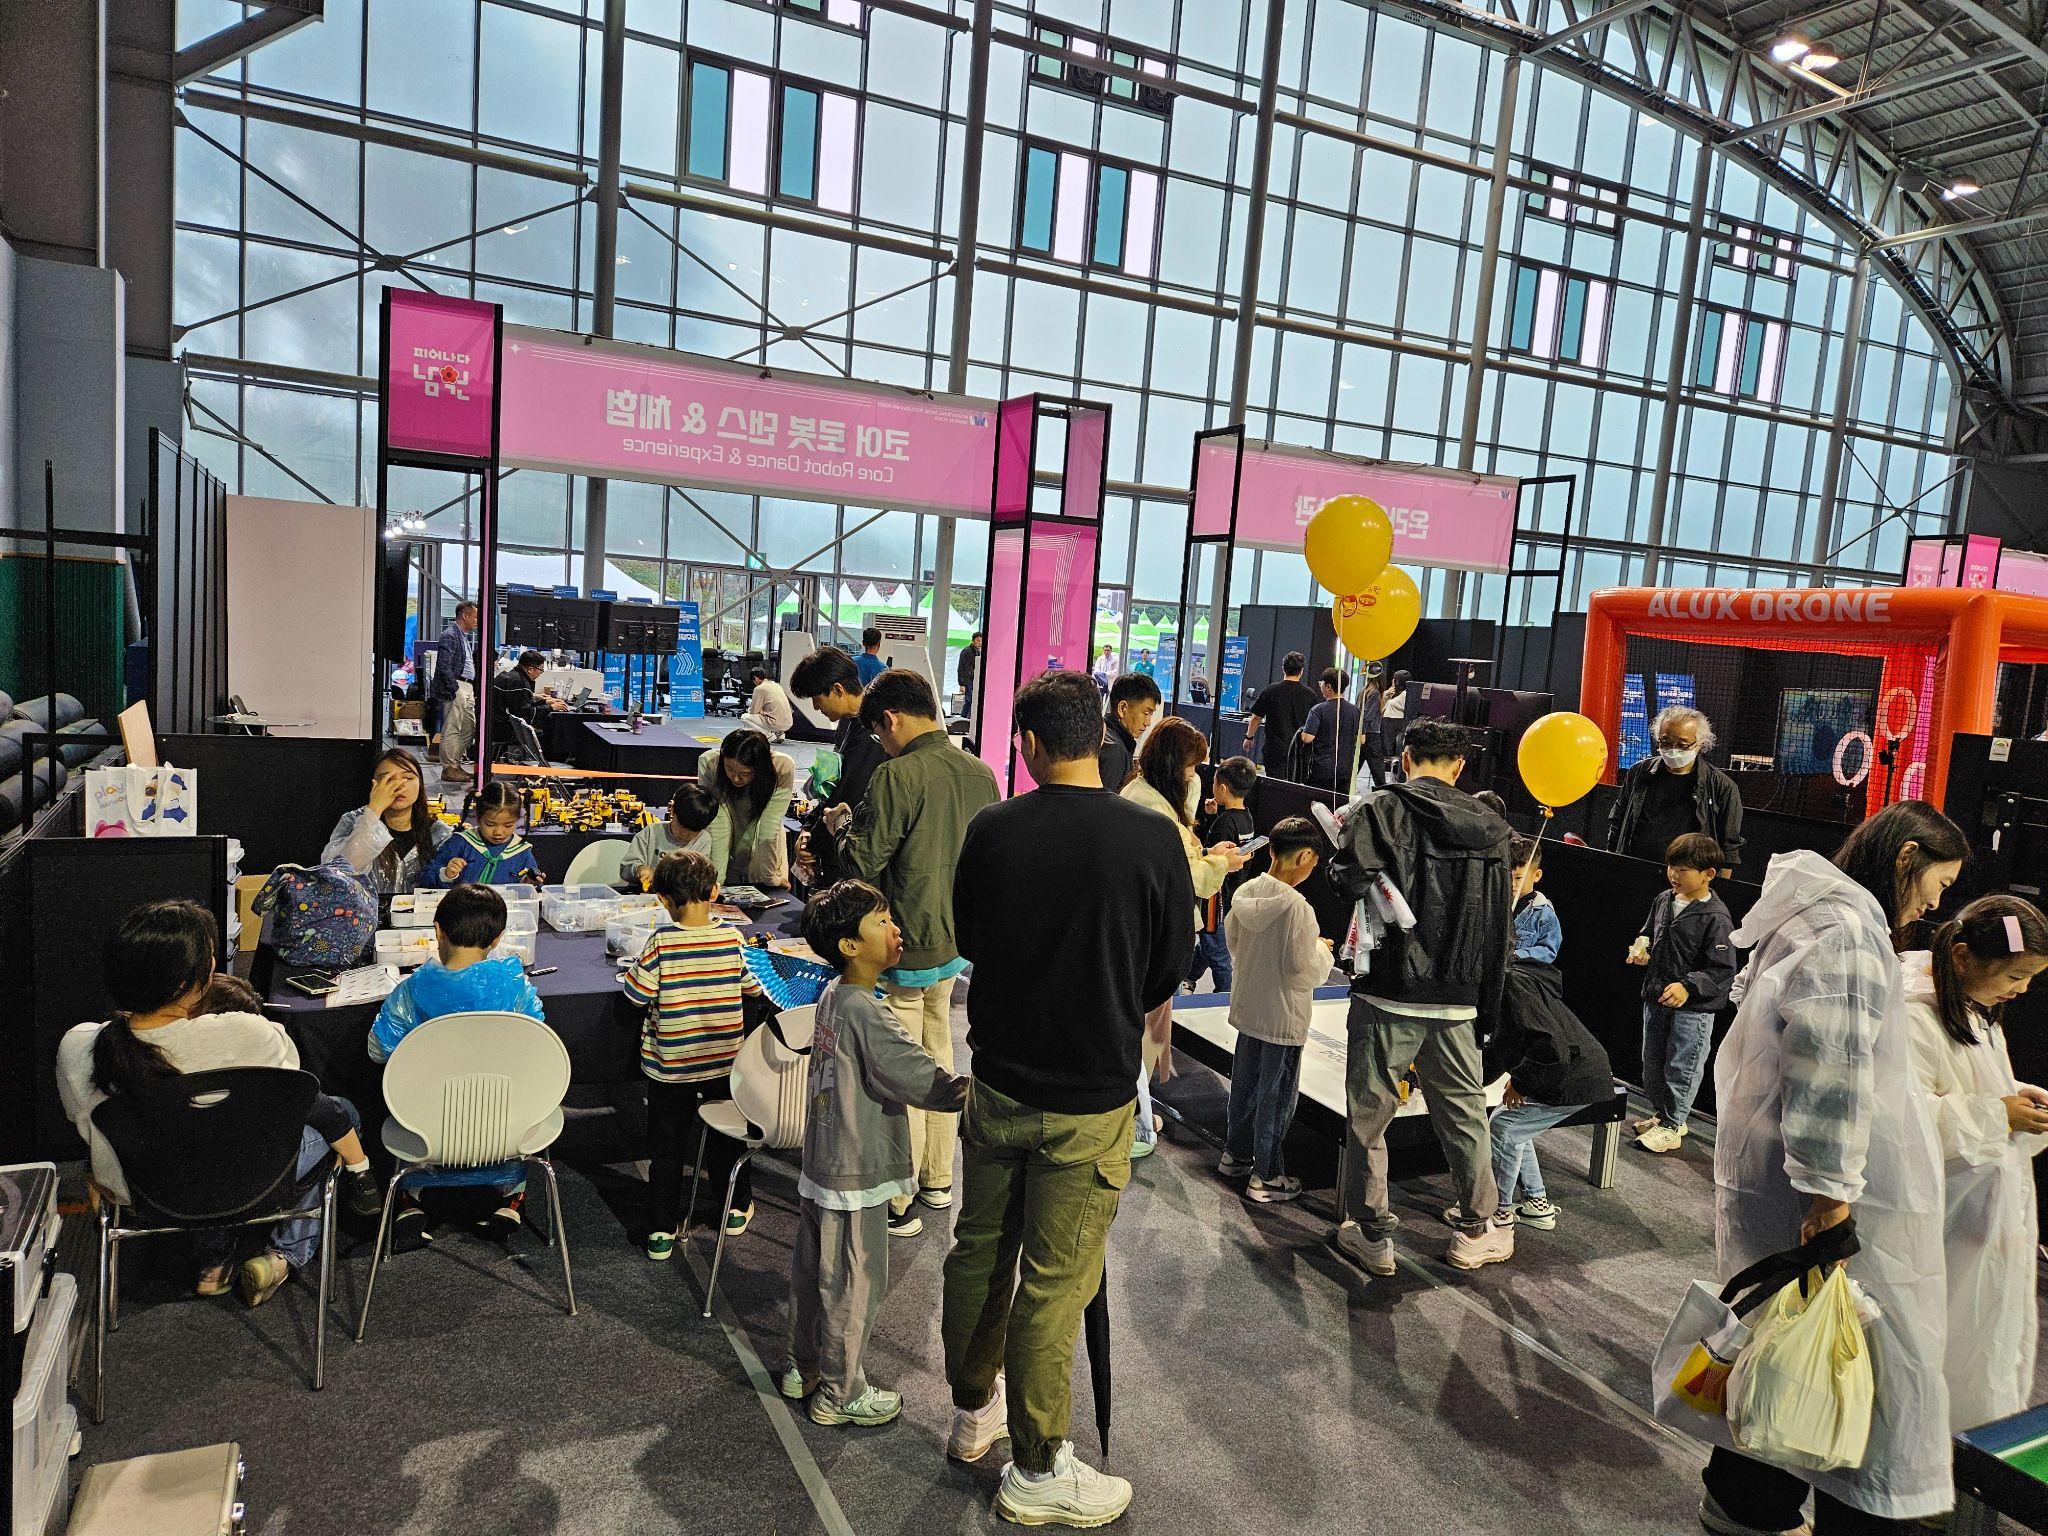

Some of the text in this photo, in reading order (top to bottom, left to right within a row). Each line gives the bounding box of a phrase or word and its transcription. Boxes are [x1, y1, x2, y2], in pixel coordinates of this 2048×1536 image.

[414, 347, 471, 364] 피어나다
[1648, 591, 1893, 623] ALUX DRONE
